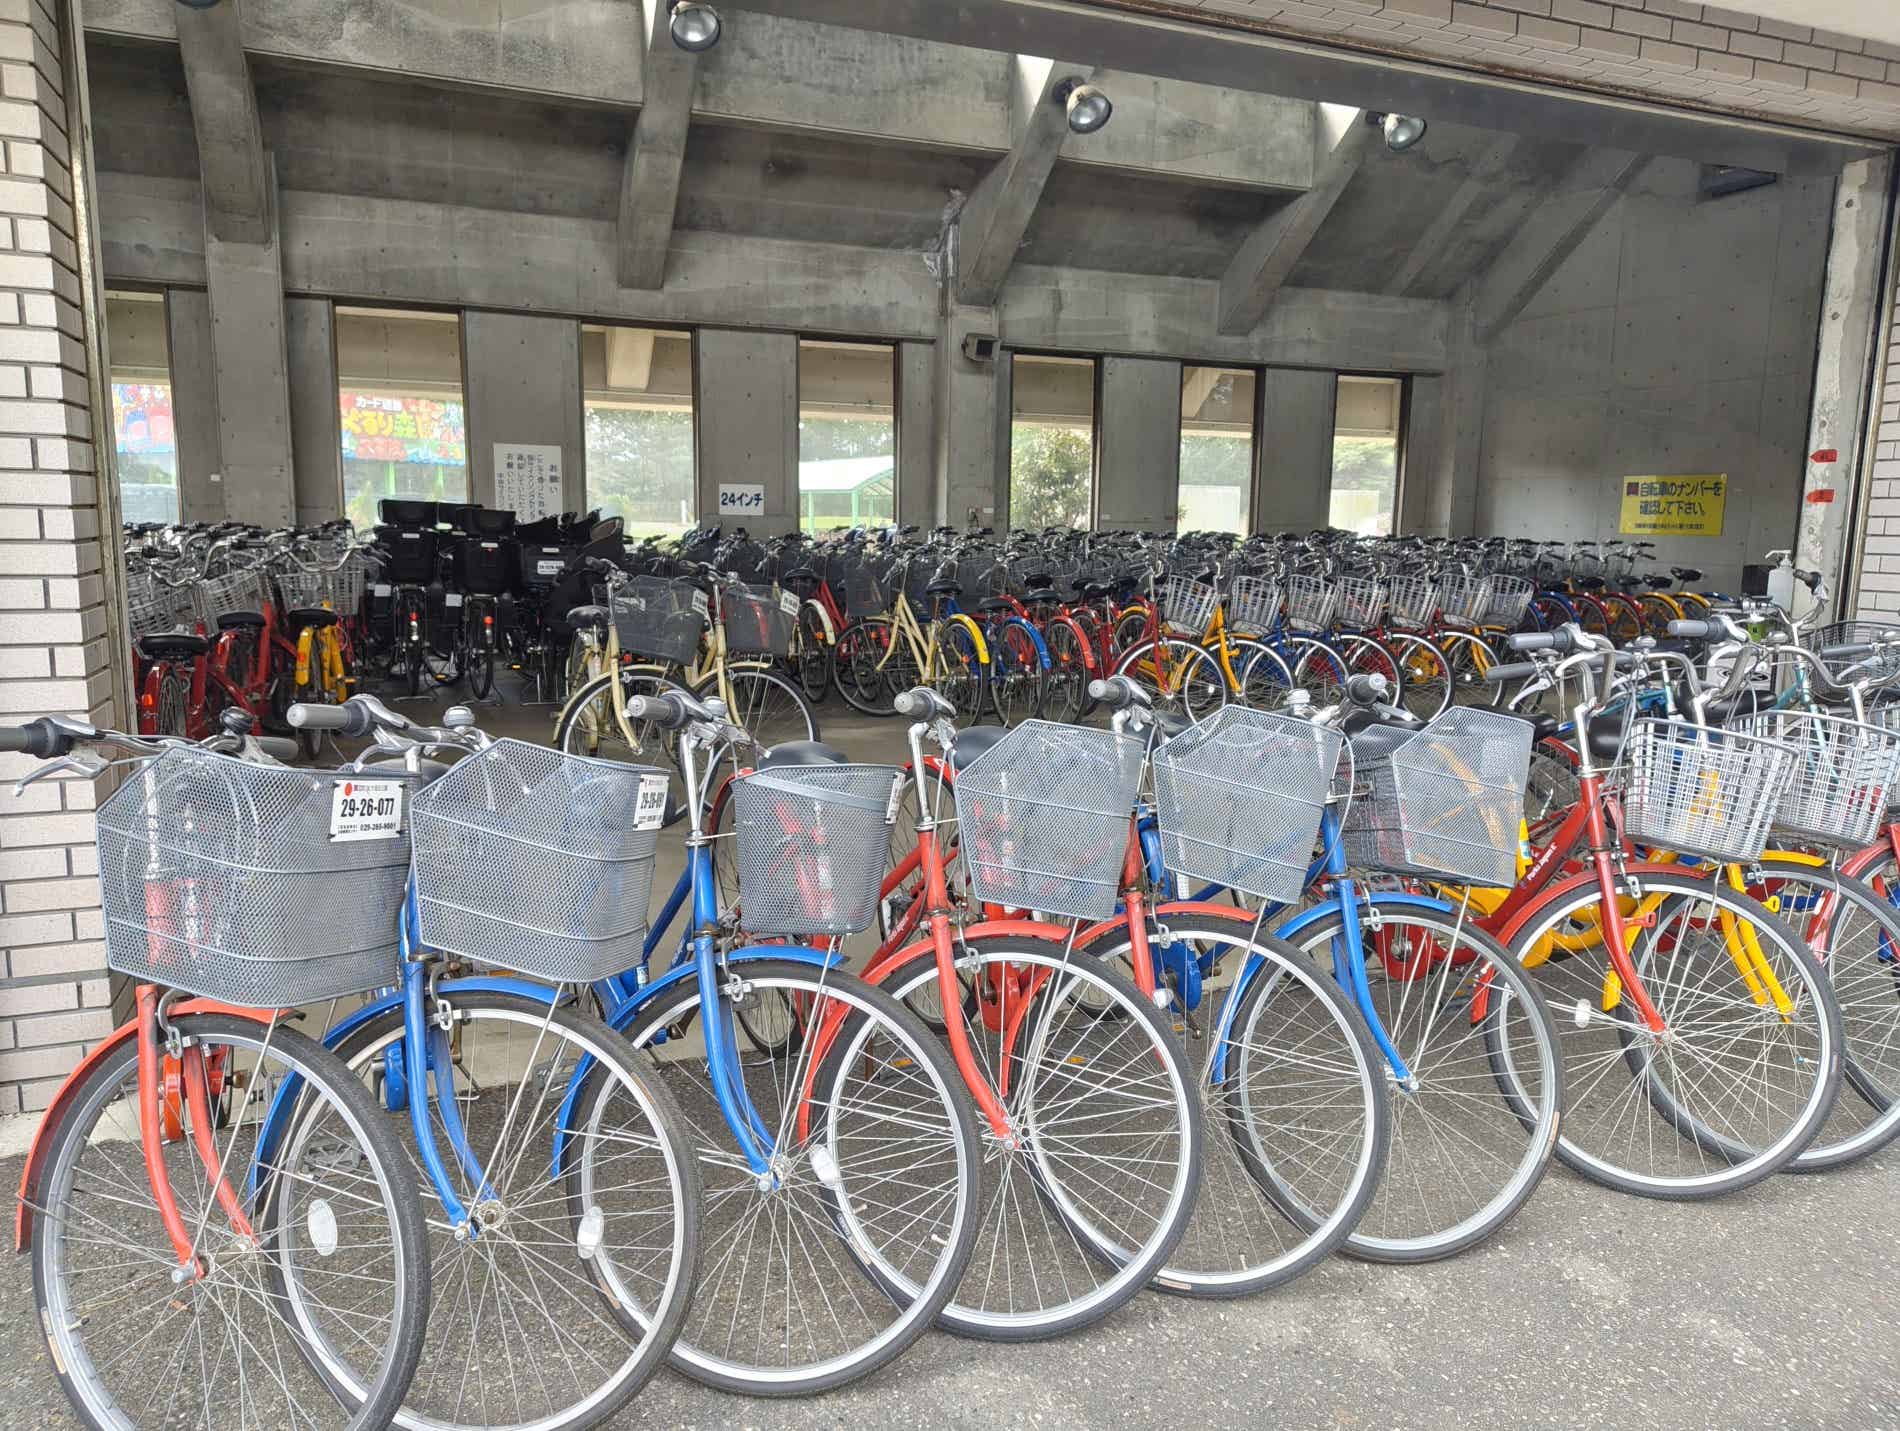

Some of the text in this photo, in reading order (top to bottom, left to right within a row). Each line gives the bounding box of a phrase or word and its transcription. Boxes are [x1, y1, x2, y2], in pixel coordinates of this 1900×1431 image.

[721, 492, 763, 507] 24インチ
[341, 798, 395, 817] 29-26-077
